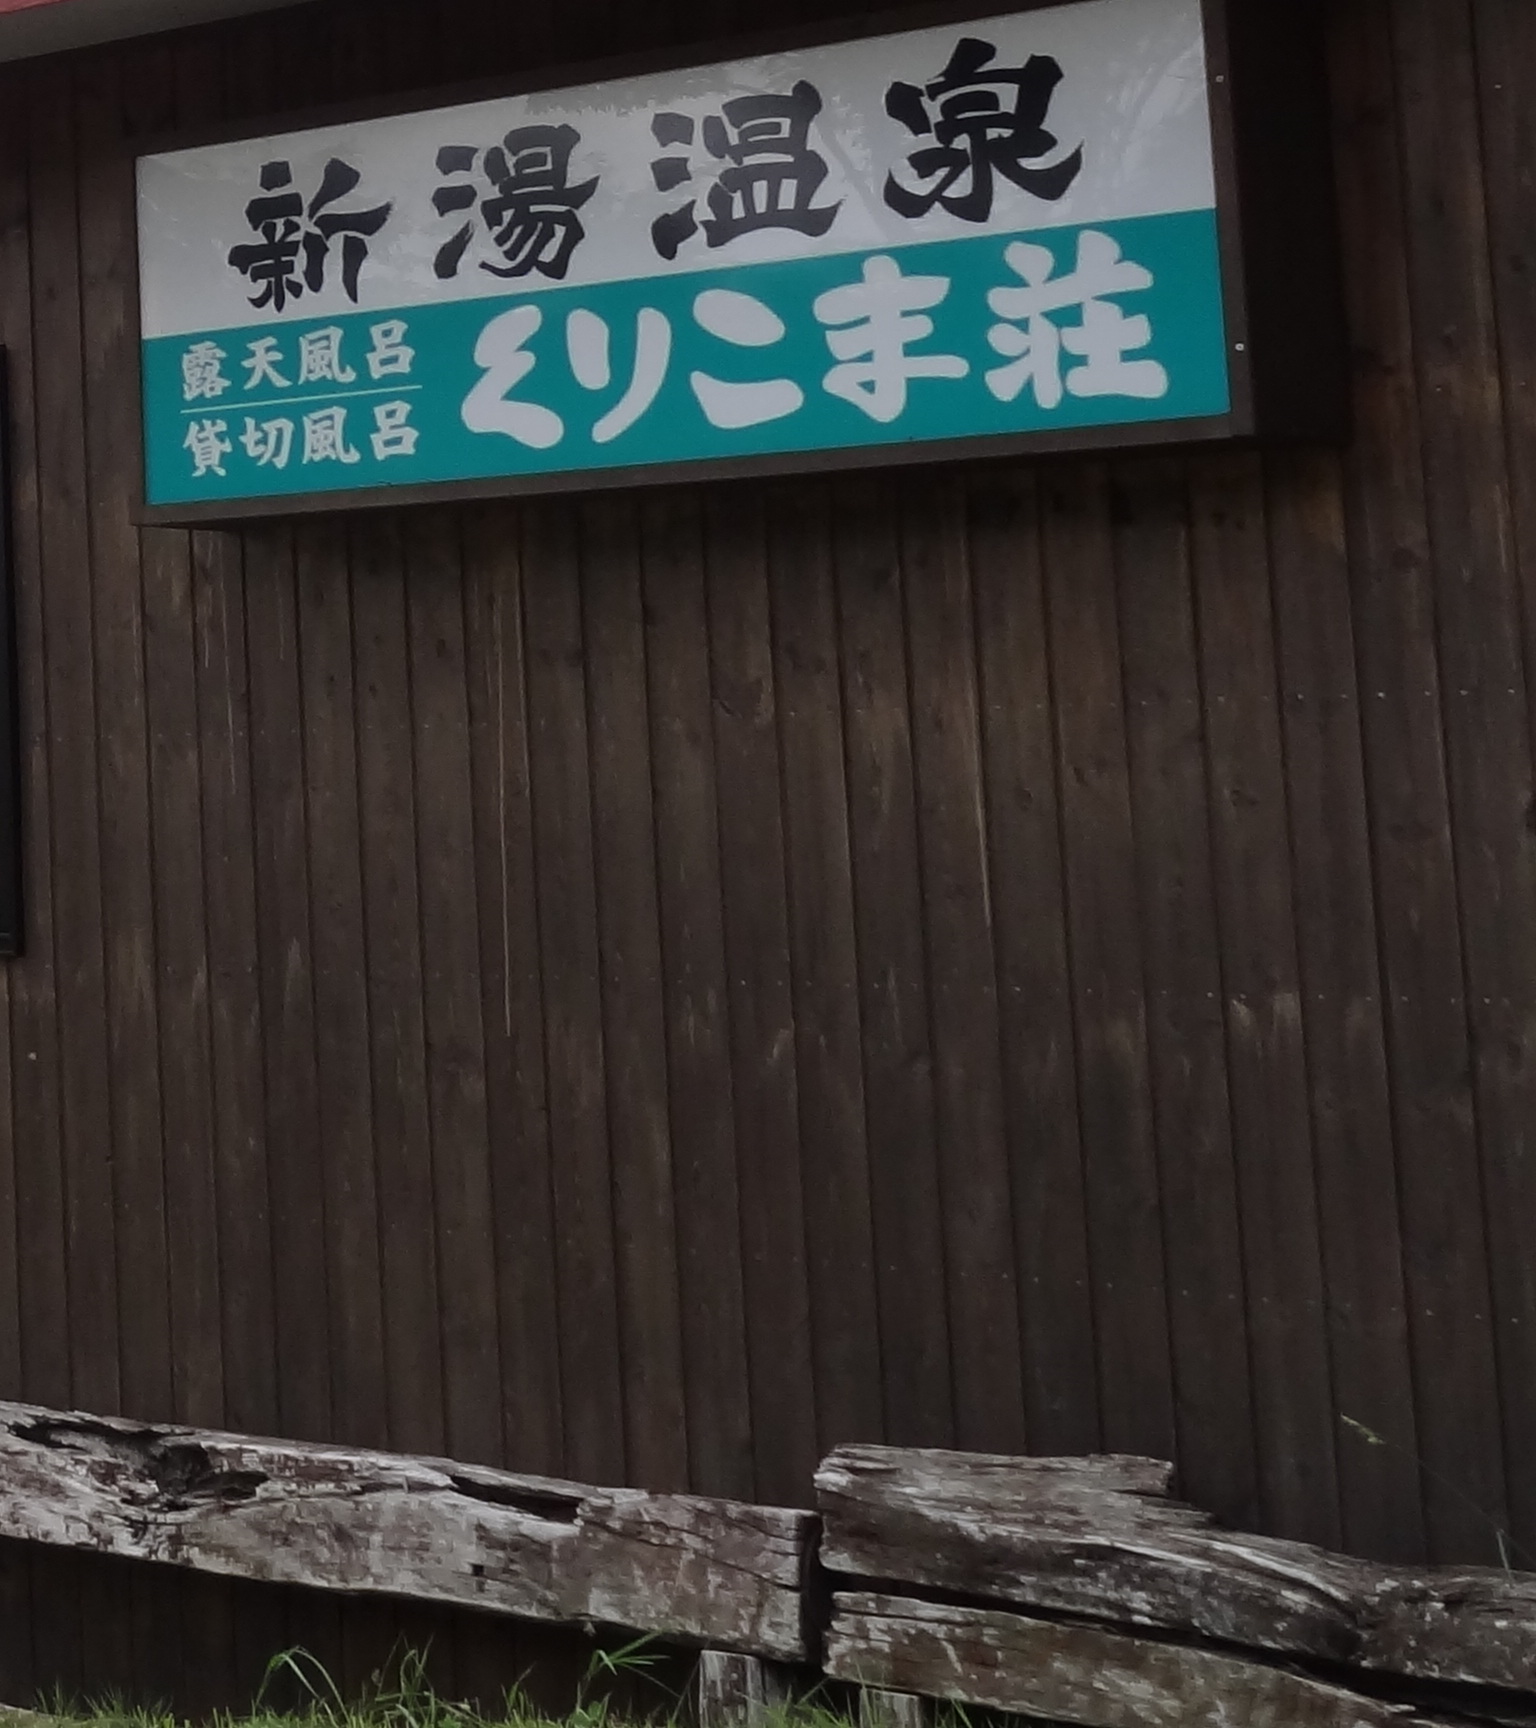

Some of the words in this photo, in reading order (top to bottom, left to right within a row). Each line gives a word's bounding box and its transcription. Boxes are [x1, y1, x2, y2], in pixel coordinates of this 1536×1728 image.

[227, 37, 1083, 313] 新湯温泉
[181, 319, 415, 401] 露天風呂
[461, 230, 1167, 448] くりこま荘
[183, 400, 419, 477] 貸切風呂
